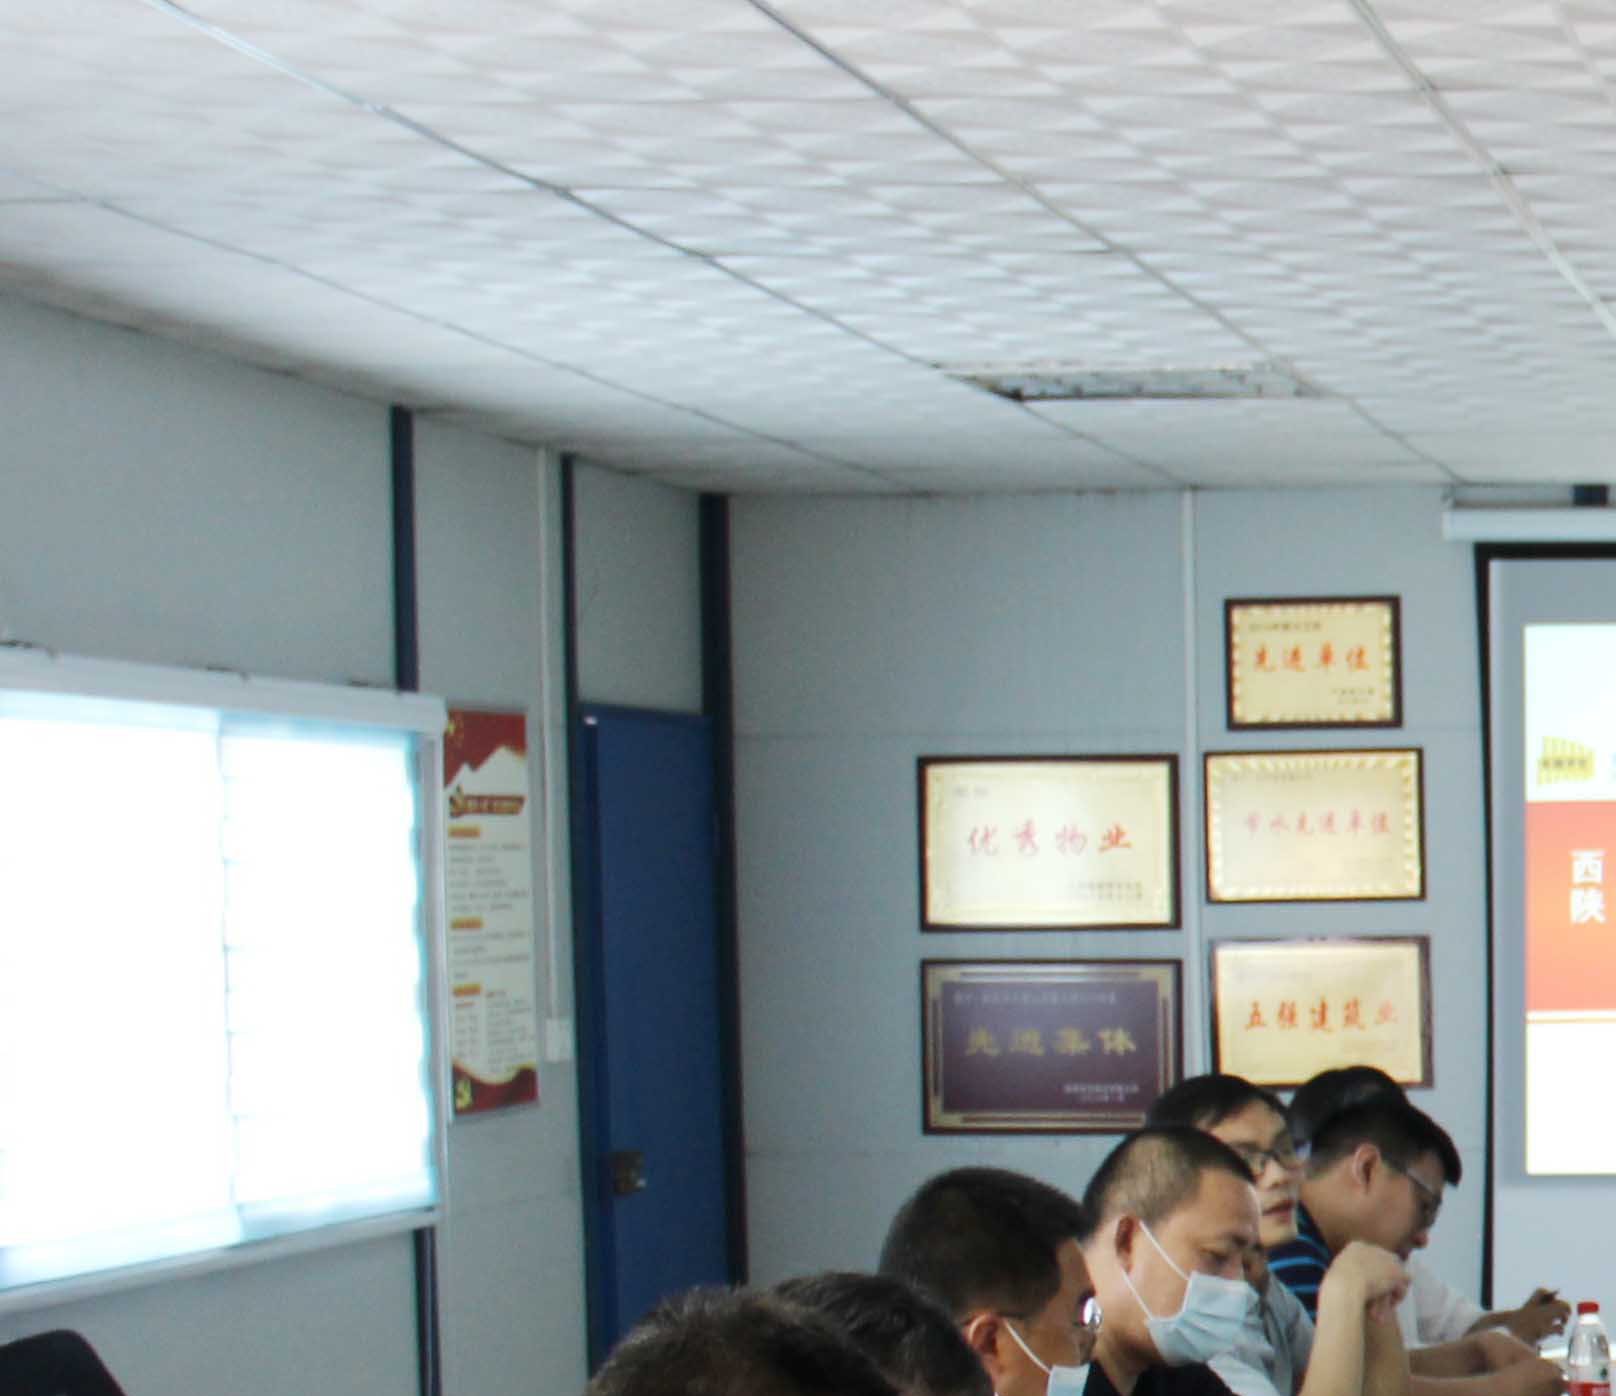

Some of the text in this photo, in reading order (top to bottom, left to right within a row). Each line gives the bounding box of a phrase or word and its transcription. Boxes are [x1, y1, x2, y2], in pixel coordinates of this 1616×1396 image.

[1251, 644, 1371, 674] 先进单位
[967, 819, 1133, 858] 优秀物业
